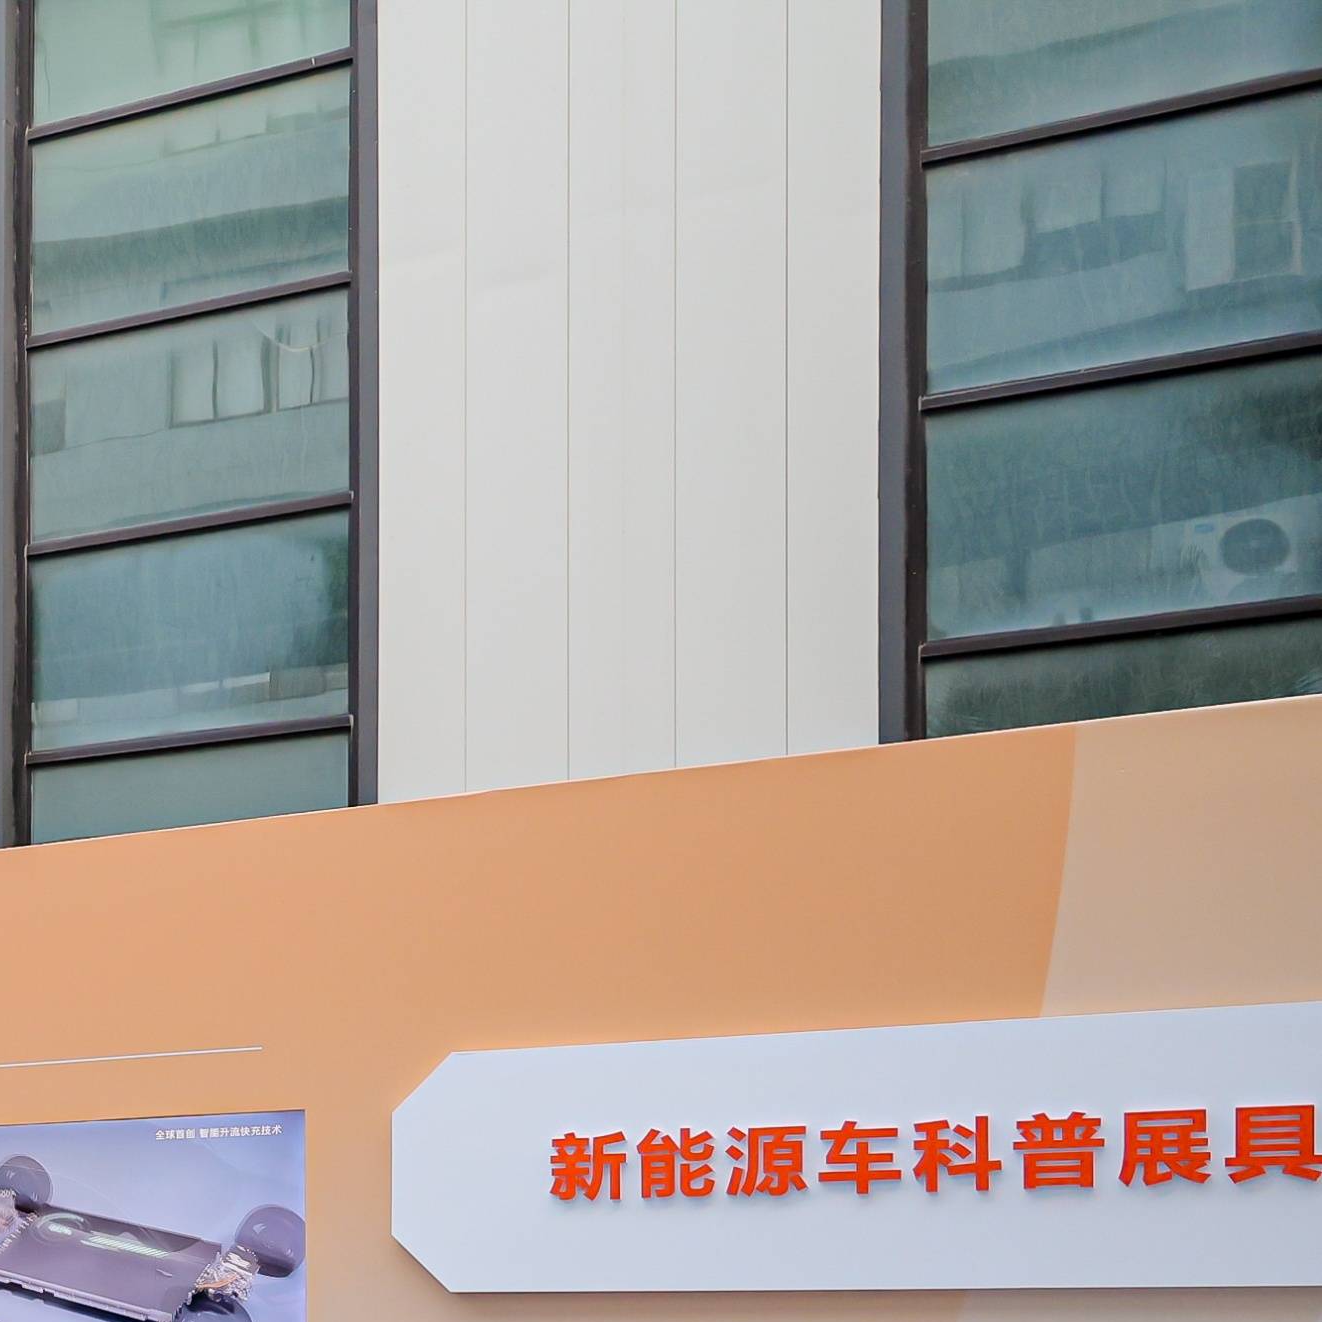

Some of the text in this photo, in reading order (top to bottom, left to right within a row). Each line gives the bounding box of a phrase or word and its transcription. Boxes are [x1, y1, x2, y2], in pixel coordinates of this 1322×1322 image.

[548, 1103, 1322, 1202] 新能源车科普展具
